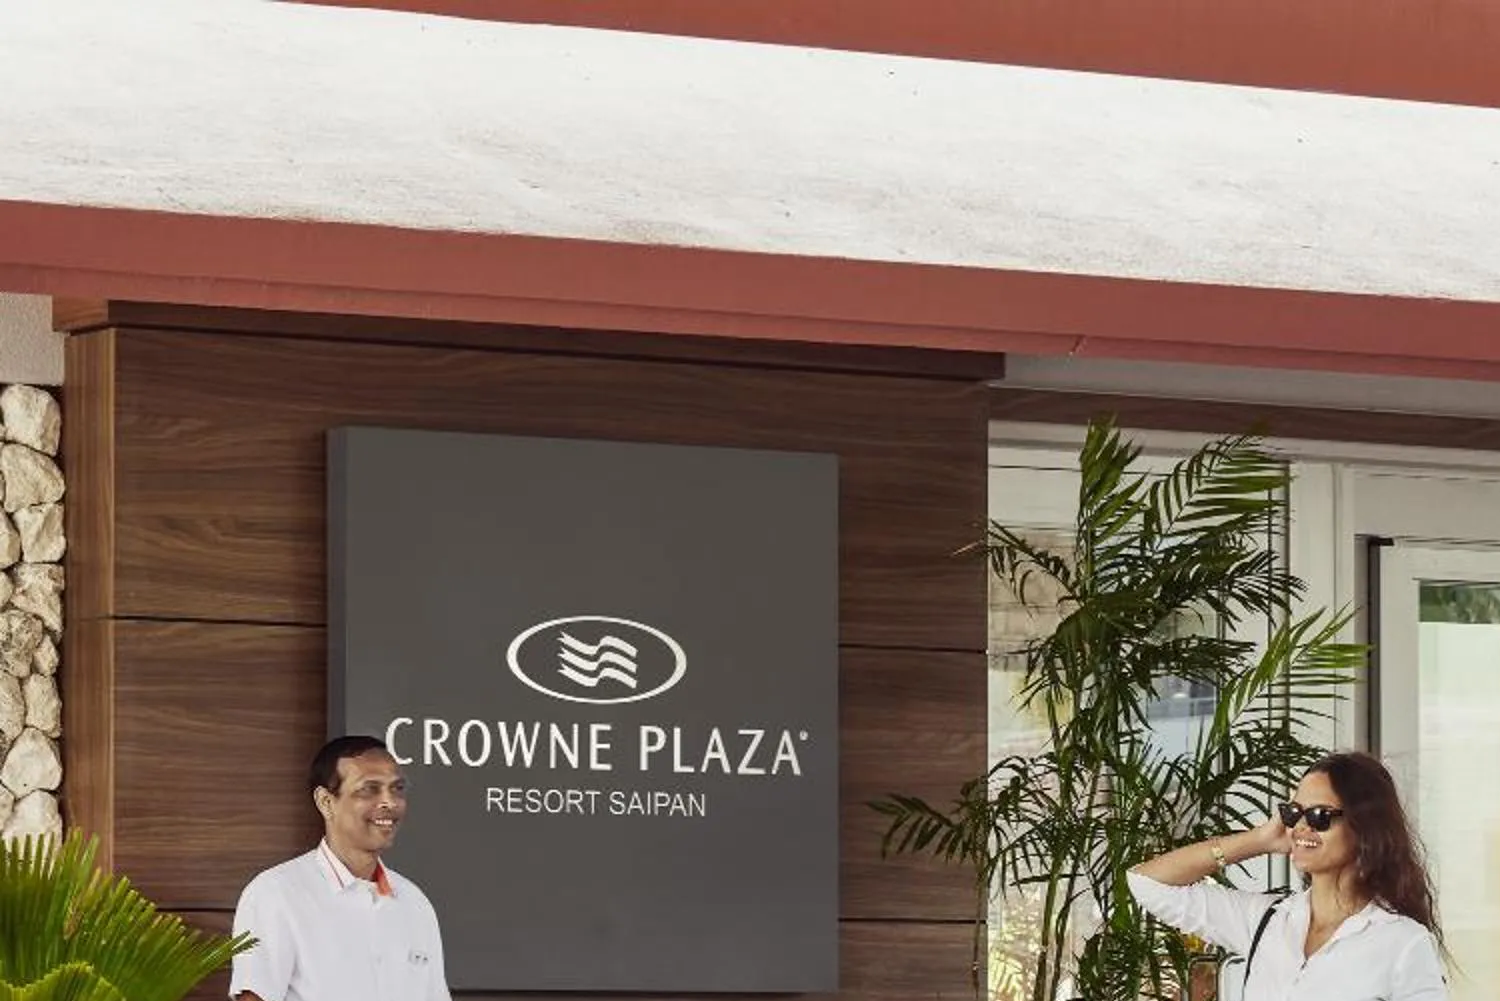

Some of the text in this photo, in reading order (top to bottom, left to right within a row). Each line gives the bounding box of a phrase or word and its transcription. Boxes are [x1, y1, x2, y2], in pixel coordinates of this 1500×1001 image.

[385, 716, 803, 776] CROWNE PLAZA
[487, 787, 707, 818] RESORT SAIPAN
